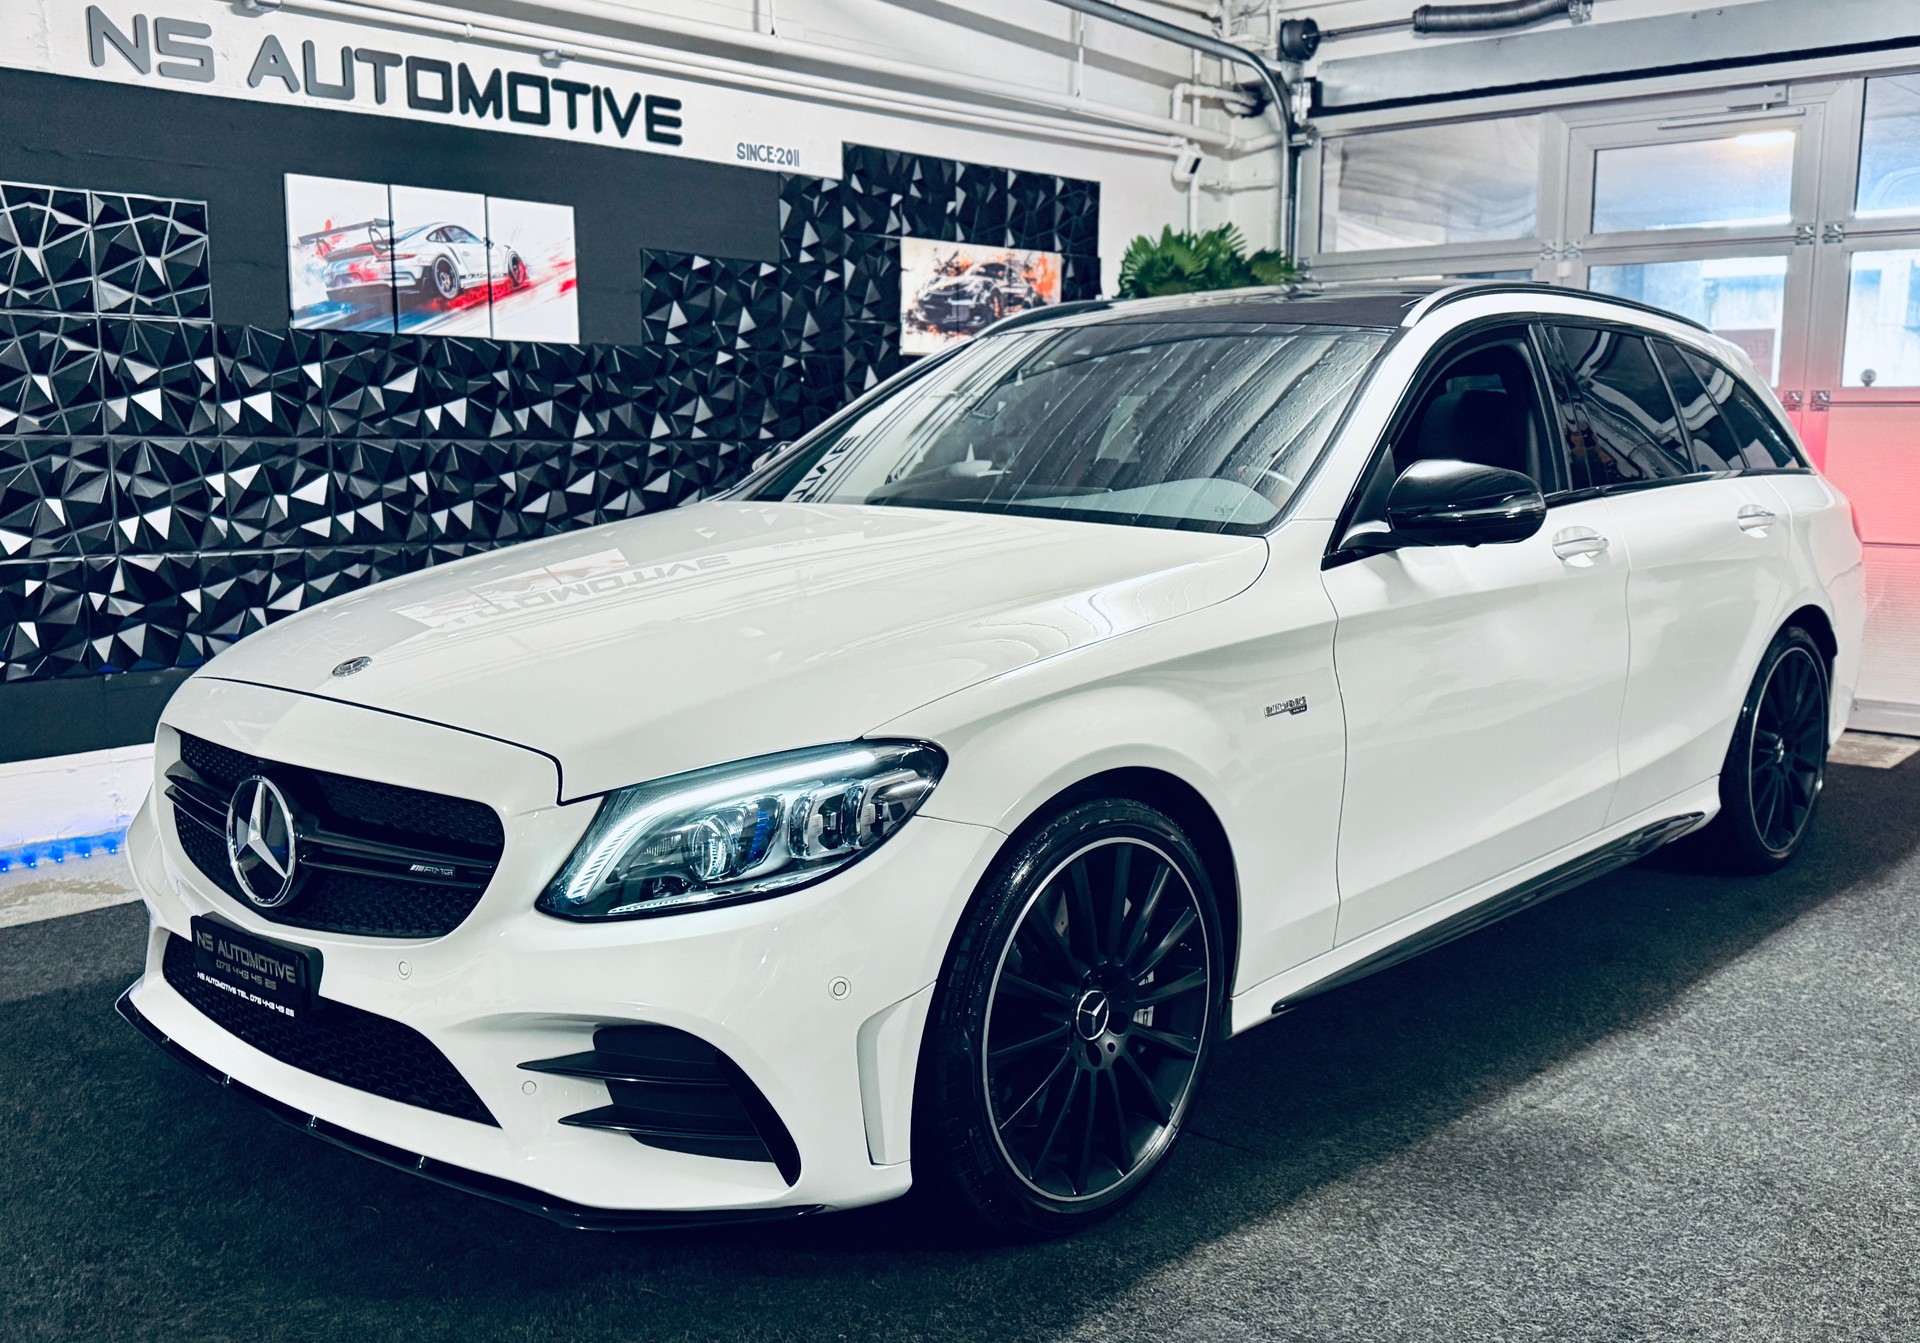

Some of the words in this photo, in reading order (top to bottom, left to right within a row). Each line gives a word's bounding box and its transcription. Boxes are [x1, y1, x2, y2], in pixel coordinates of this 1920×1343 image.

[86, 5, 215, 82] NS
[247, 34, 683, 146] AUTOMOTIVE
[196, 930, 214, 952] NS
[218, 940, 296, 984] AUTOMOTIVE
